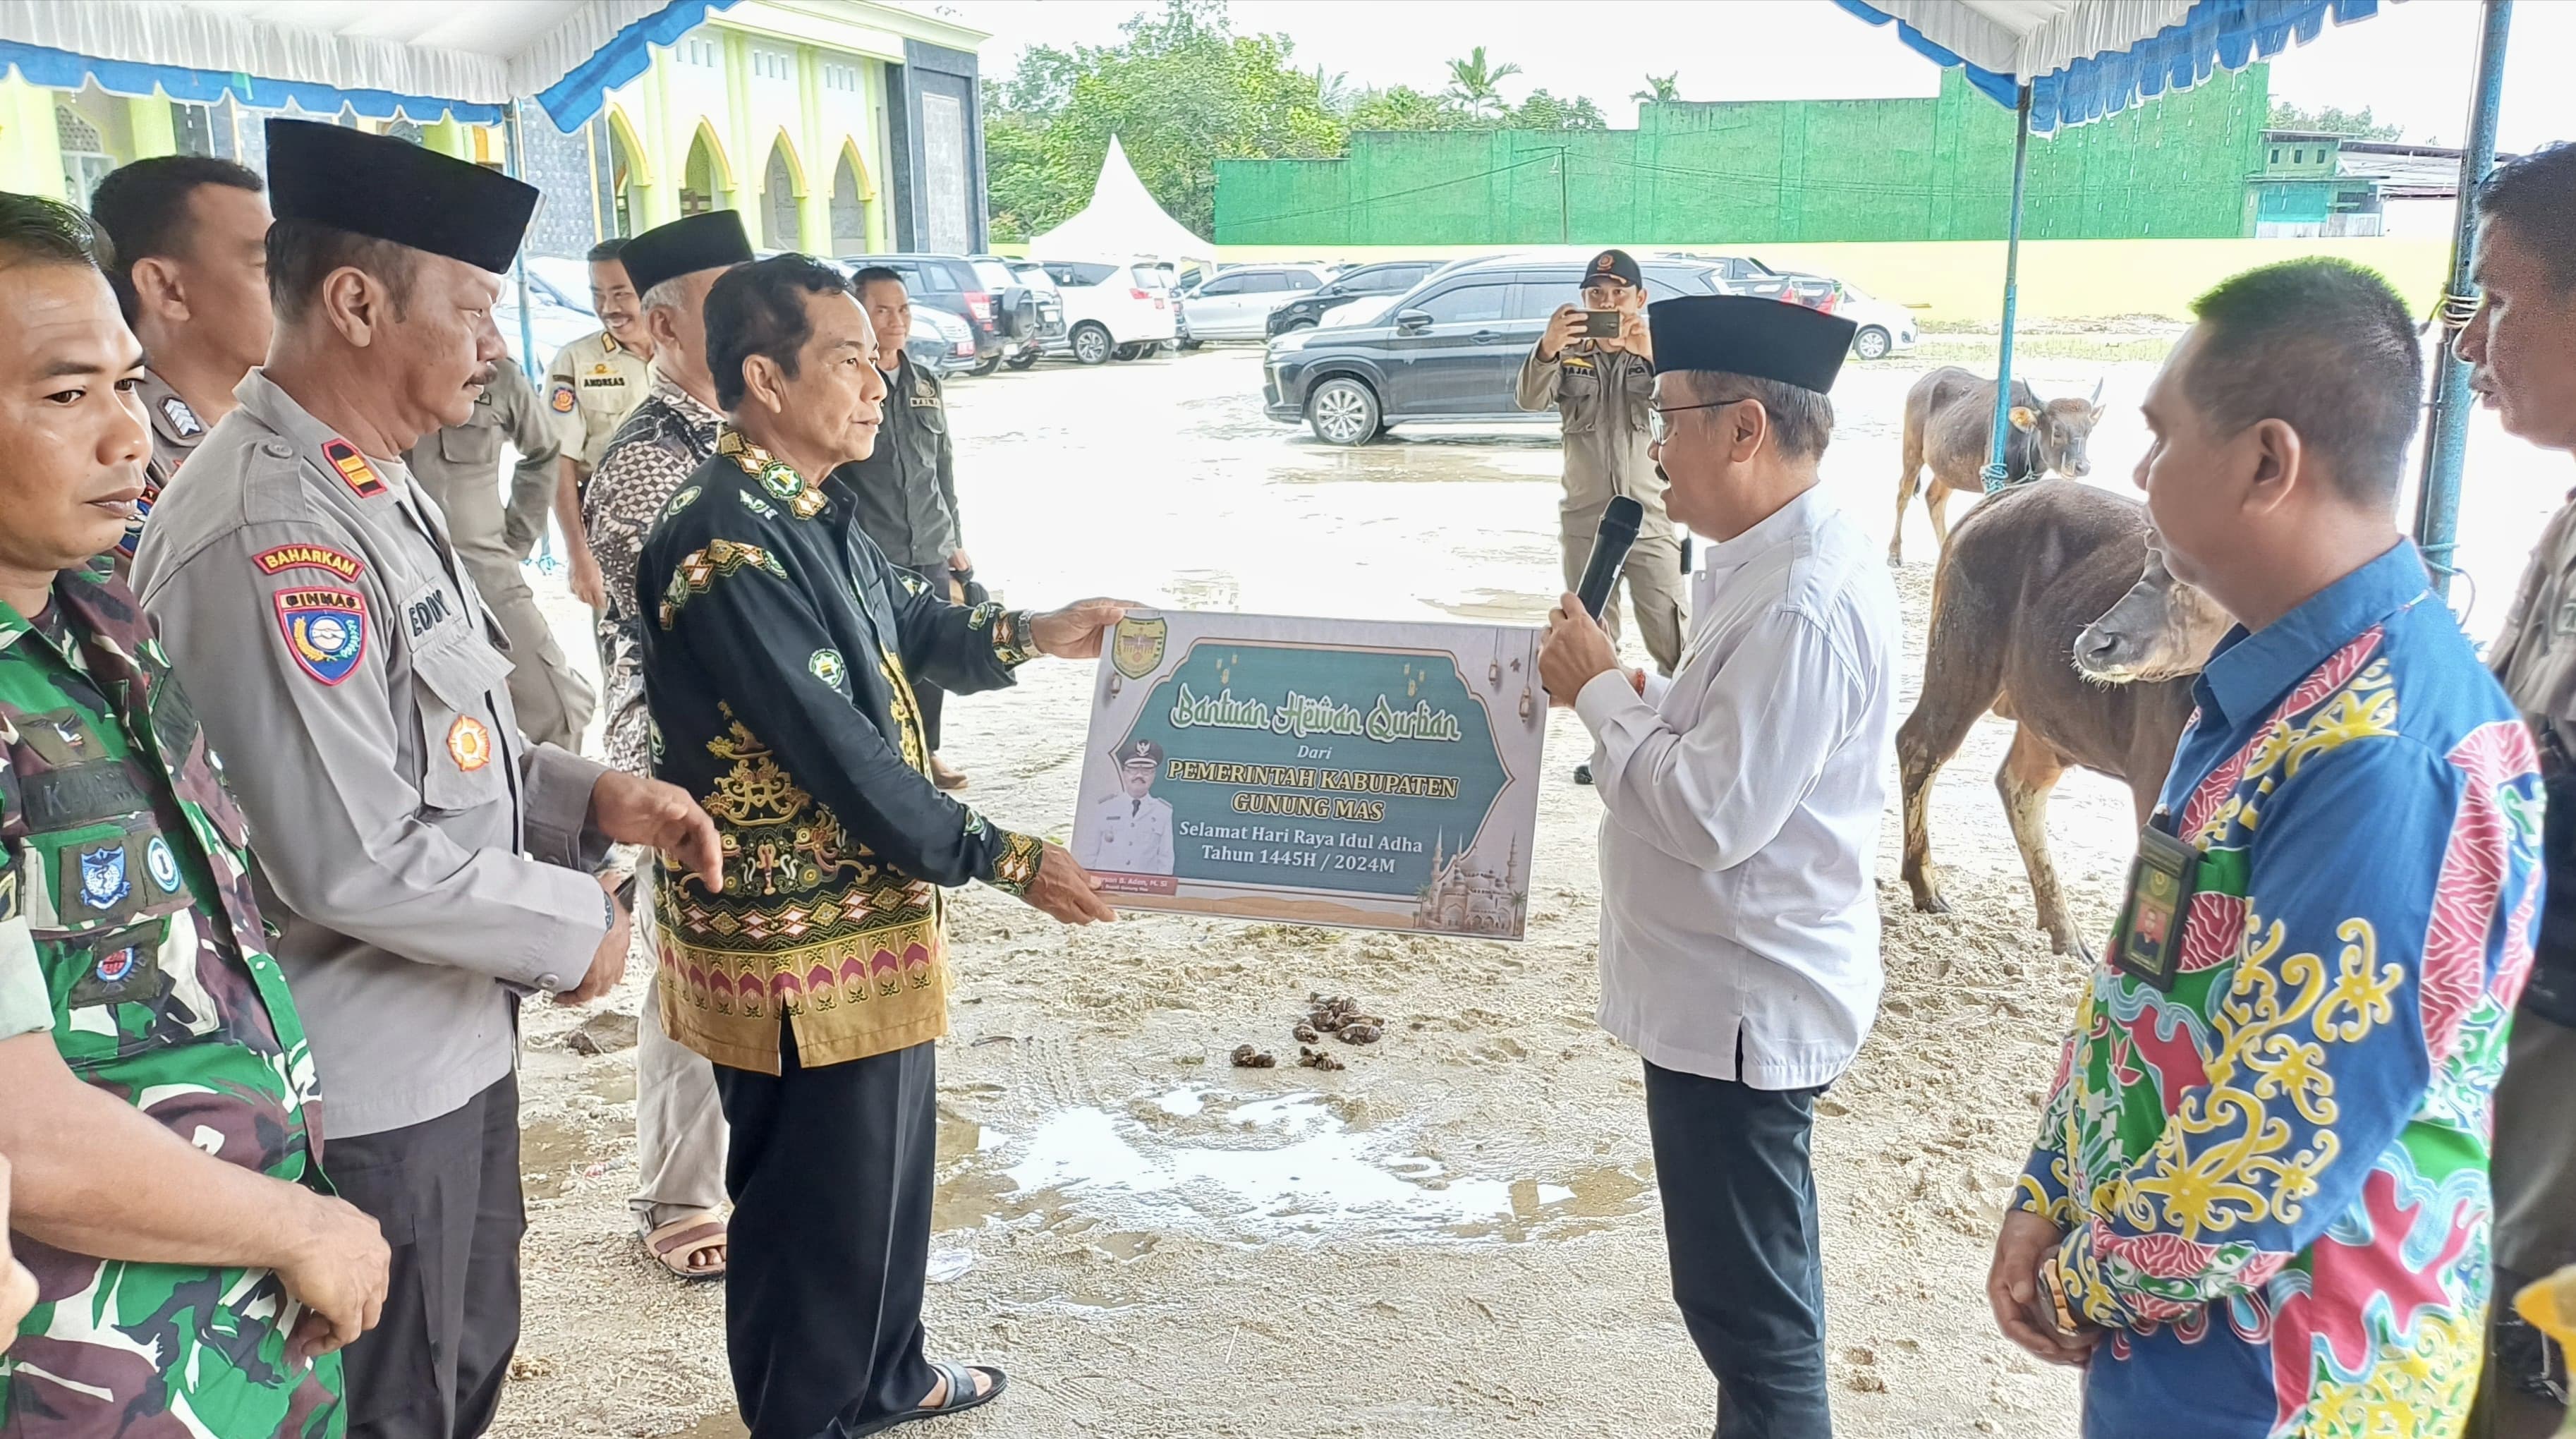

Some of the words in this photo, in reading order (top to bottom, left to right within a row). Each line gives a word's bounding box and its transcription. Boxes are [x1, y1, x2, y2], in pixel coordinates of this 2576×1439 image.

[584, 377, 625, 387] ANDREAS
[265, 547, 356, 576] BAHARKAM
[408, 589, 451, 637] EDDY
[1170, 683, 1270, 729] Bantuan
[1366, 694, 1462, 743] Qurban
[1297, 745, 1332, 760] Dari
[1167, 759, 1317, 789] PEMERINTAH
[1319, 769, 1459, 799] KABUPATEN
[1232, 791, 1330, 819] GUNUNG
[1333, 799, 1385, 822] MAS
[1179, 821, 1248, 839] Selamat
[1252, 827, 1292, 842] Hari
[1294, 830, 1334, 849] Raya
[1339, 833, 1373, 849] Idul
[1378, 836, 1423, 853] Adha
[1202, 845, 1254, 863] Tahun
[1260, 849, 1316, 867] 1445H
[1320, 854, 1331, 872] /
[1334, 855, 1395, 873] 2024M
